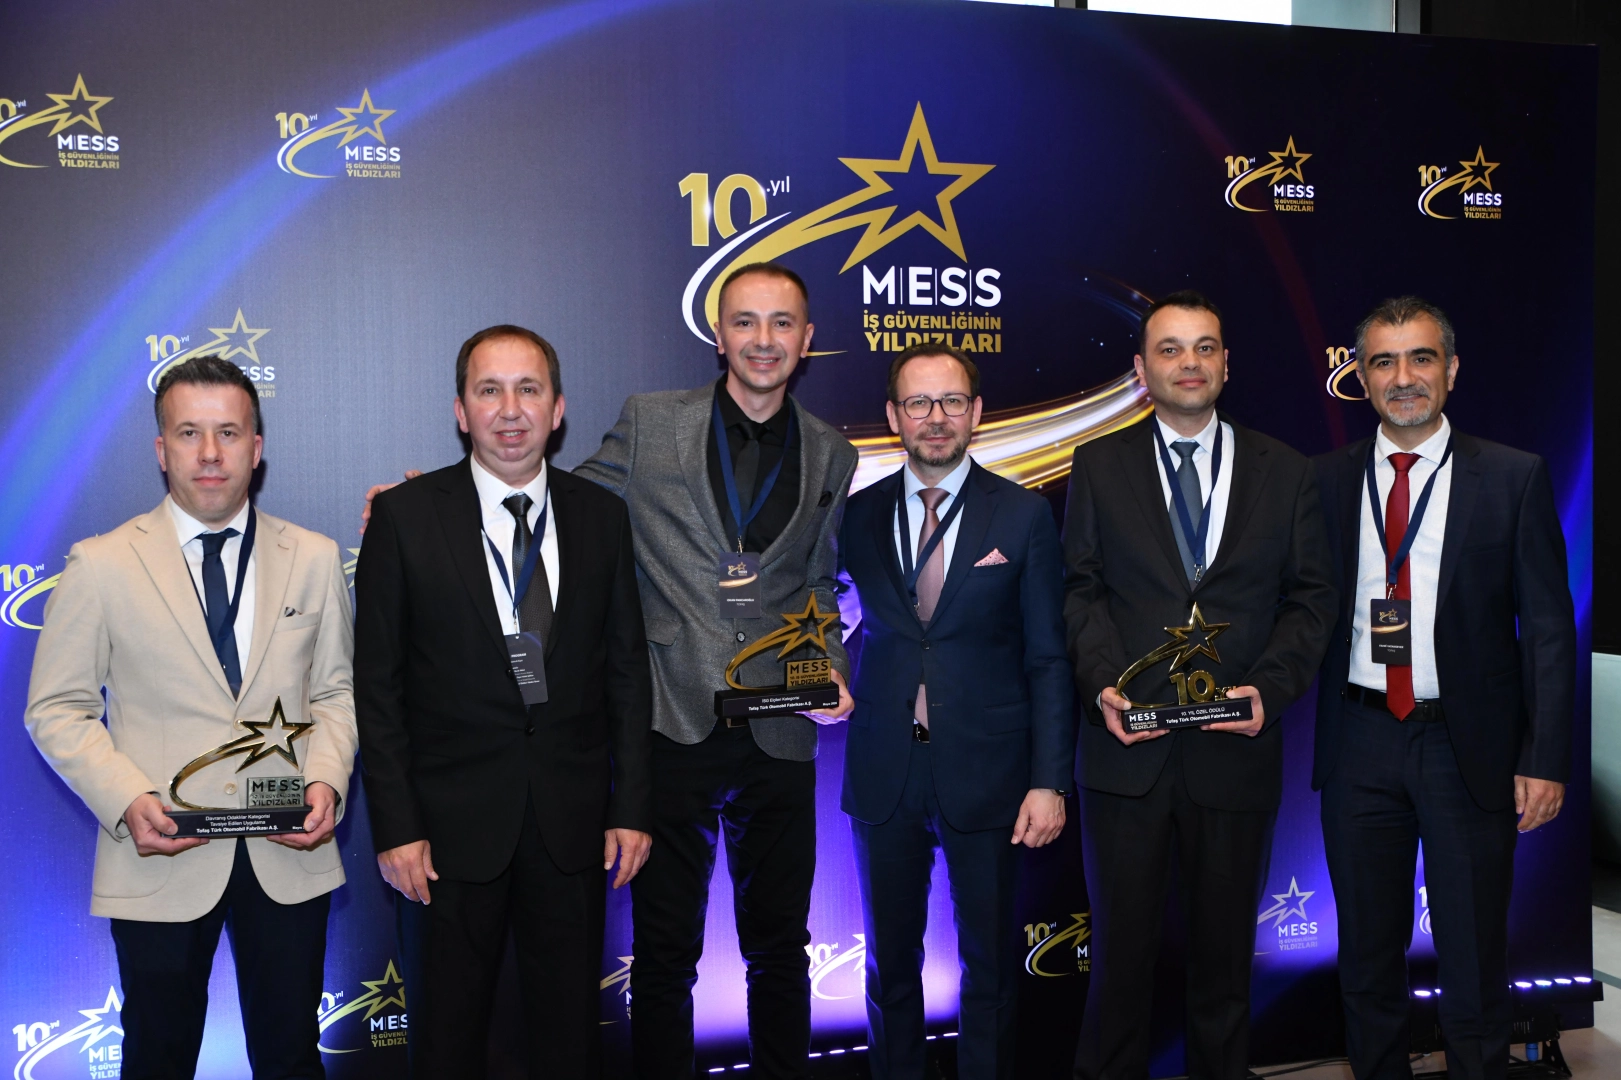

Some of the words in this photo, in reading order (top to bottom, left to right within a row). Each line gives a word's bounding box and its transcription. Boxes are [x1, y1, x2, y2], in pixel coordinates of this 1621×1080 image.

[275, 112, 309, 139] 10
[57, 134, 120, 152] MESS
[345, 145, 401, 162] MESS
[59, 159, 120, 169] YILDIZLARI
[1224, 155, 1249, 178] 10
[346, 169, 401, 178] YILDIZLARI
[1417, 164, 1441, 187] 10
[1274, 184, 1315, 198] MESS
[1464, 192, 1502, 206] MESS
[678, 172, 767, 247] 10
[1274, 204, 1314, 212] YILDIZLARI
[1464, 211, 1502, 219] YILDIZLARI
[863, 265, 1002, 308] MESS
[863, 309, 880, 333] İŞ
[883, 310, 1002, 330] GÜVENLİĞİNİN
[145, 334, 181, 361] 10
[1325, 346, 1350, 369] 10
[790, 660, 829, 674] MESS
[790, 677, 829, 686] YILDIZLARI
[1169, 669, 1216, 705] 10
[1129, 712, 1157, 722] MESS
[252, 779, 301, 792] MESS
[252, 798, 301, 806] YILDIZLARI
[1023, 922, 1050, 947] 10
[1278, 921, 1318, 937] MESS
[1278, 941, 1318, 951] YILDIZLARI
[370, 1014, 408, 1031] MES
[12, 1021, 50, 1052] 10
[371, 1037, 408, 1047] YILDIZL
[378, 1030, 407, 1039] GÜVENLİ
[89, 1044, 120, 1063] ME
